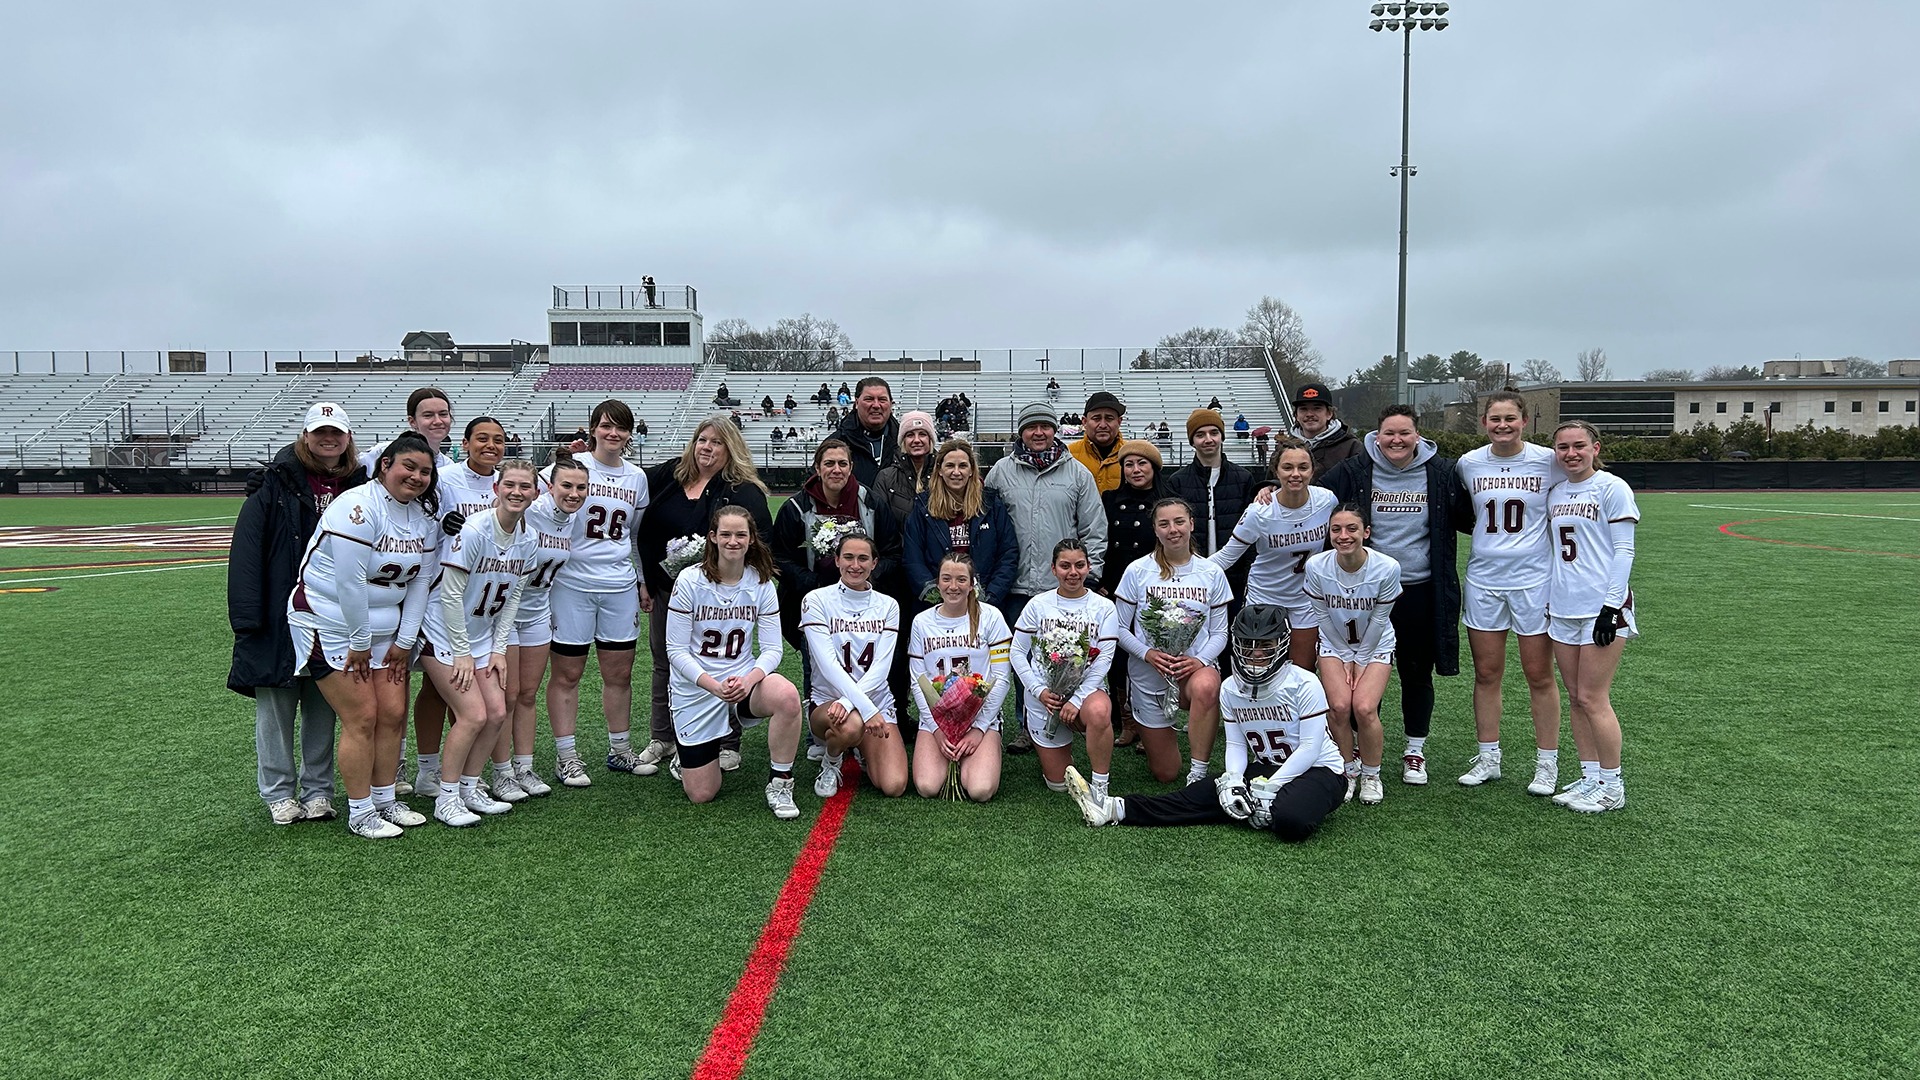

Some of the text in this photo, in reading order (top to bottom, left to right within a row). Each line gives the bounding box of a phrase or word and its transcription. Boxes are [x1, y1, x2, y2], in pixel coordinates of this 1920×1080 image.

[585, 482, 638, 507] CHORWOMEN
[1472, 476, 1542, 496] ANCHORWOMEN
[585, 503, 628, 542] 26
[1484, 497, 1527, 536] 10
[1558, 524, 1579, 564] 5
[1290, 549, 1312, 575] 7
[470, 580, 511, 618] 15
[1145, 585, 1208, 604] ANCHORWOMEN
[1324, 594, 1378, 611] NCHORWOM
[694, 604, 758, 623] ANCHORWOMEN
[699, 627, 747, 660] 20
[1344, 617, 1361, 645] 1
[841, 640, 876, 674] 14
[1232, 703, 1293, 724] NCHORWOMEN
[1245, 728, 1294, 766] 25
